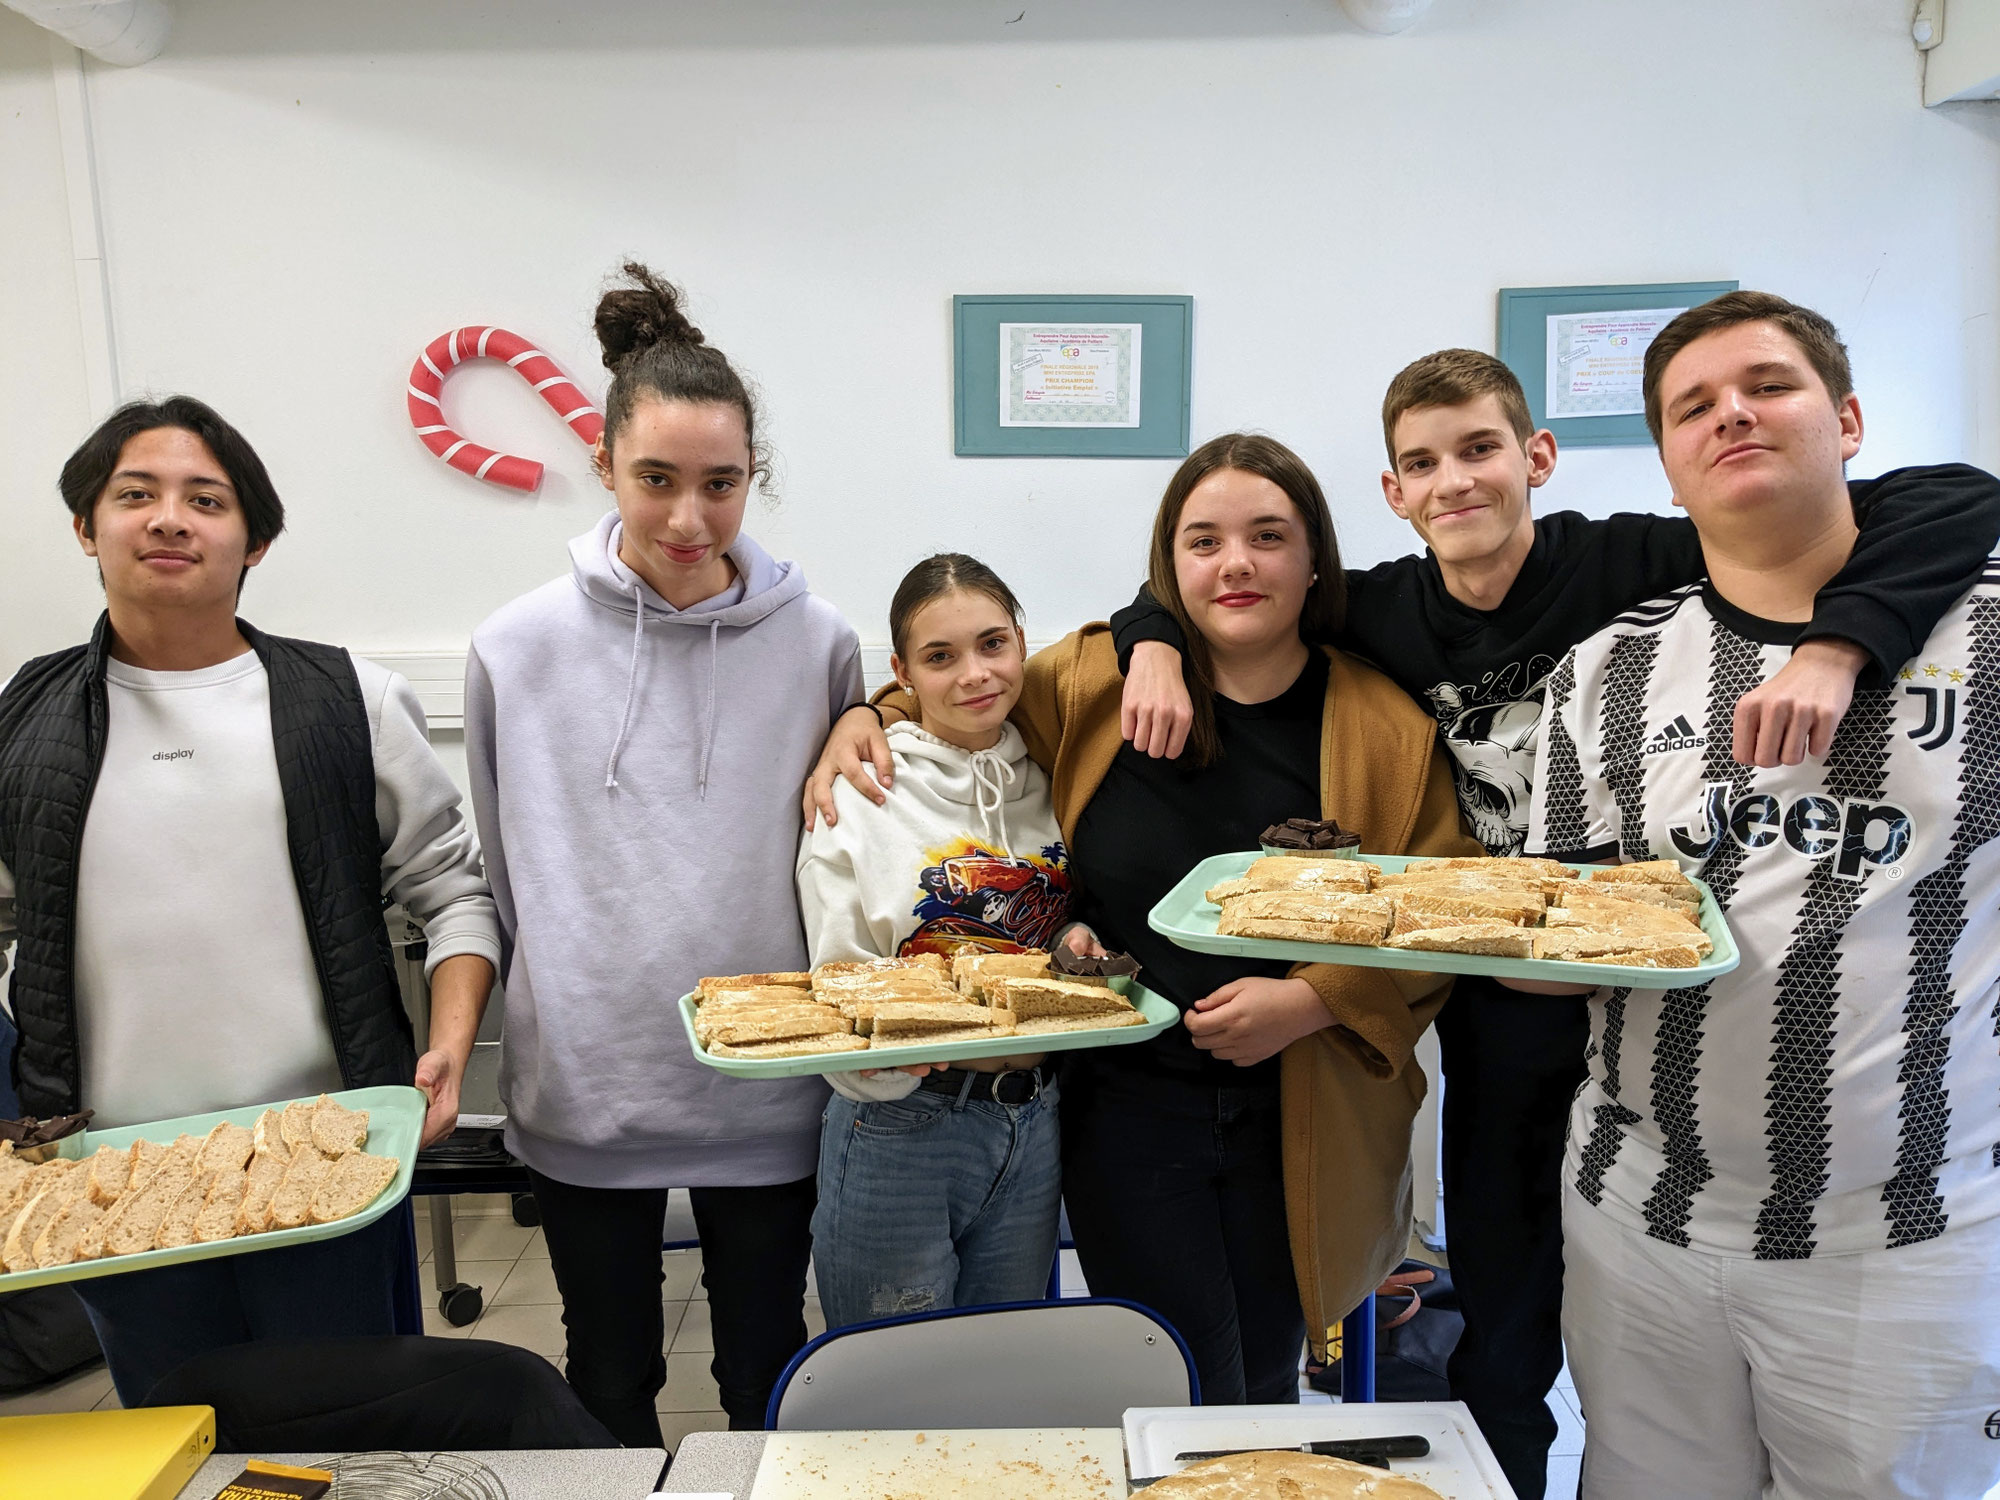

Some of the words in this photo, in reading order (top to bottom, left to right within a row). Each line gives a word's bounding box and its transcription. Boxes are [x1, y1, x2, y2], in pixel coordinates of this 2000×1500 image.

[1646, 737, 1705, 754] adidas
[152, 748, 194, 762] display
[1666, 781, 1917, 882] Jeep
[227, 1484, 252, 1492] CACAO
